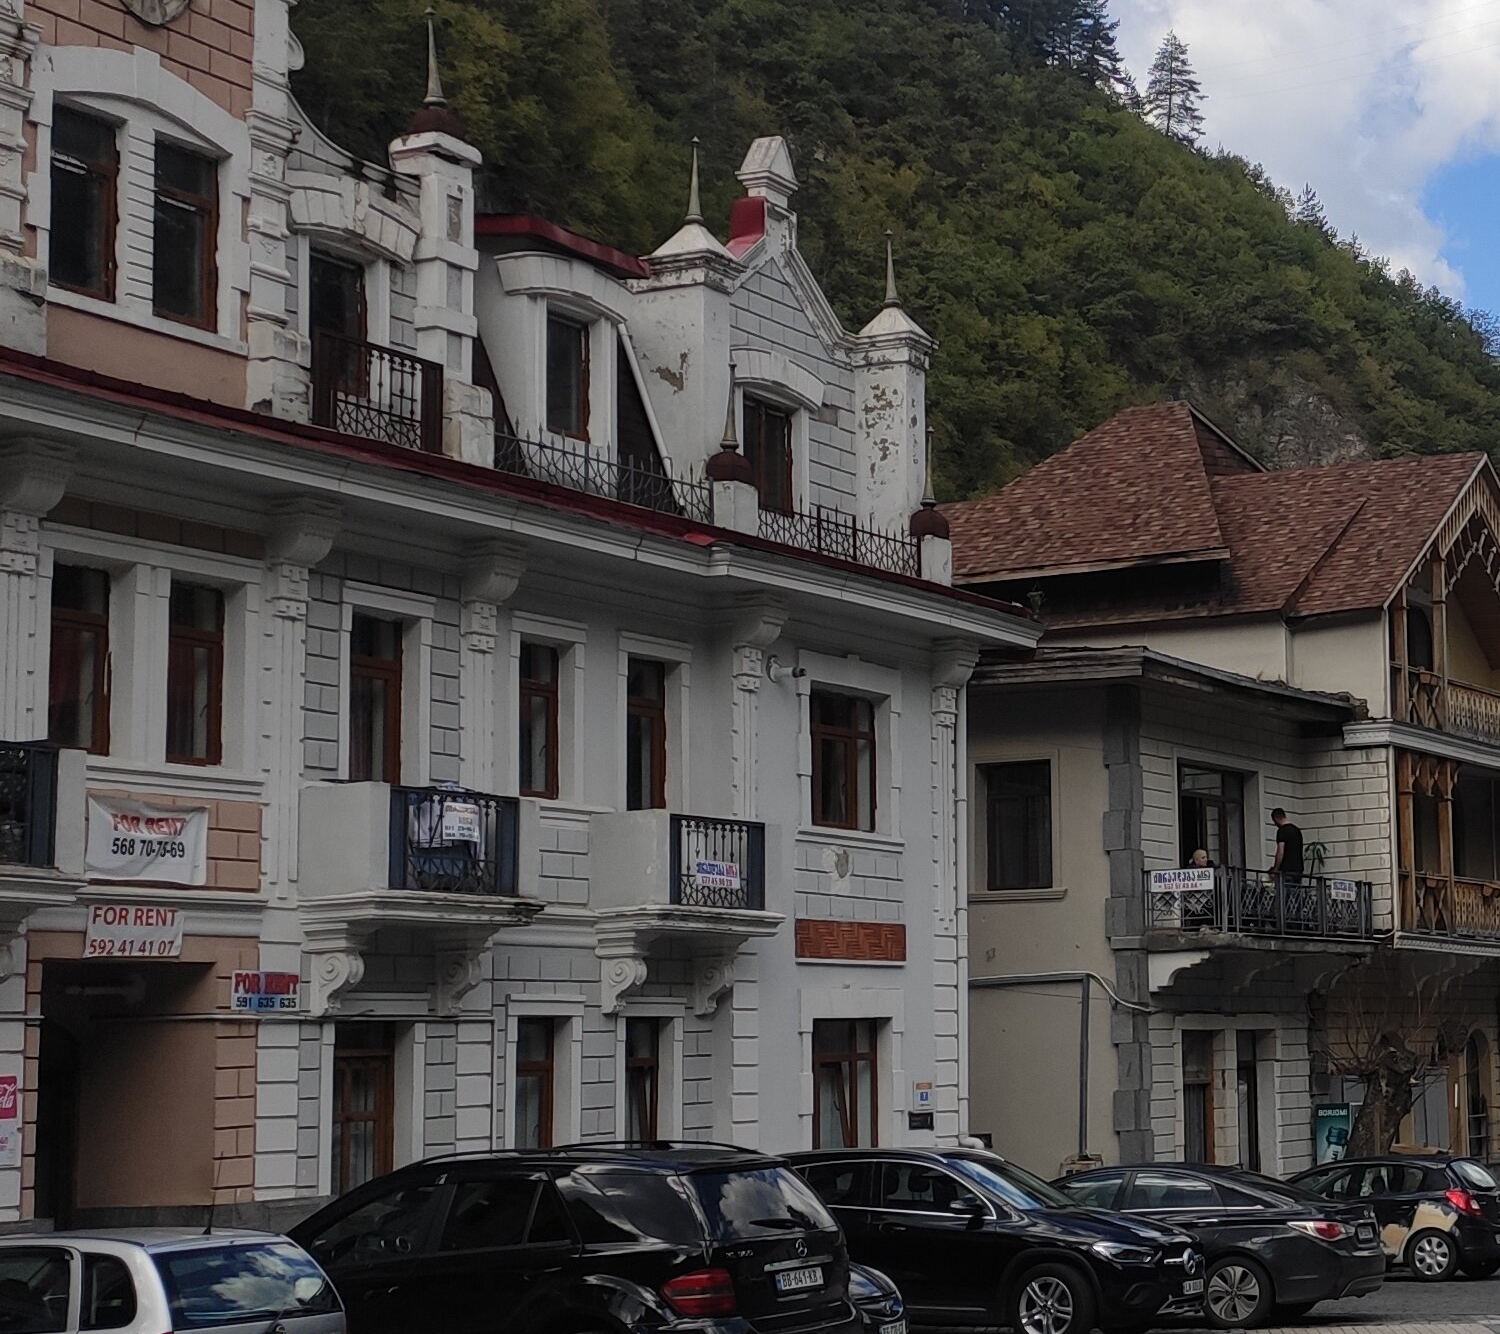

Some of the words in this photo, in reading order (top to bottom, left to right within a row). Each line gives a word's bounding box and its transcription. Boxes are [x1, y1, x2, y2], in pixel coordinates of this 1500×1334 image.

[111, 813, 144, 835] FOR
[145, 818, 186, 836] RENT
[112, 837, 135, 856] 568
[93, 906, 130, 926] FOR
[133, 908, 178, 927] RENT
[89, 938, 115, 955] 592
[118, 940, 134, 955] 41
[138, 940, 153, 955] 41
[158, 940, 175, 955] 07
[234, 972, 261, 994] FOR
[264, 973, 299, 995] RENT
[236, 996, 252, 1008] 591
[258, 997, 275, 1008] 635
[279, 998, 297, 1008] 635
